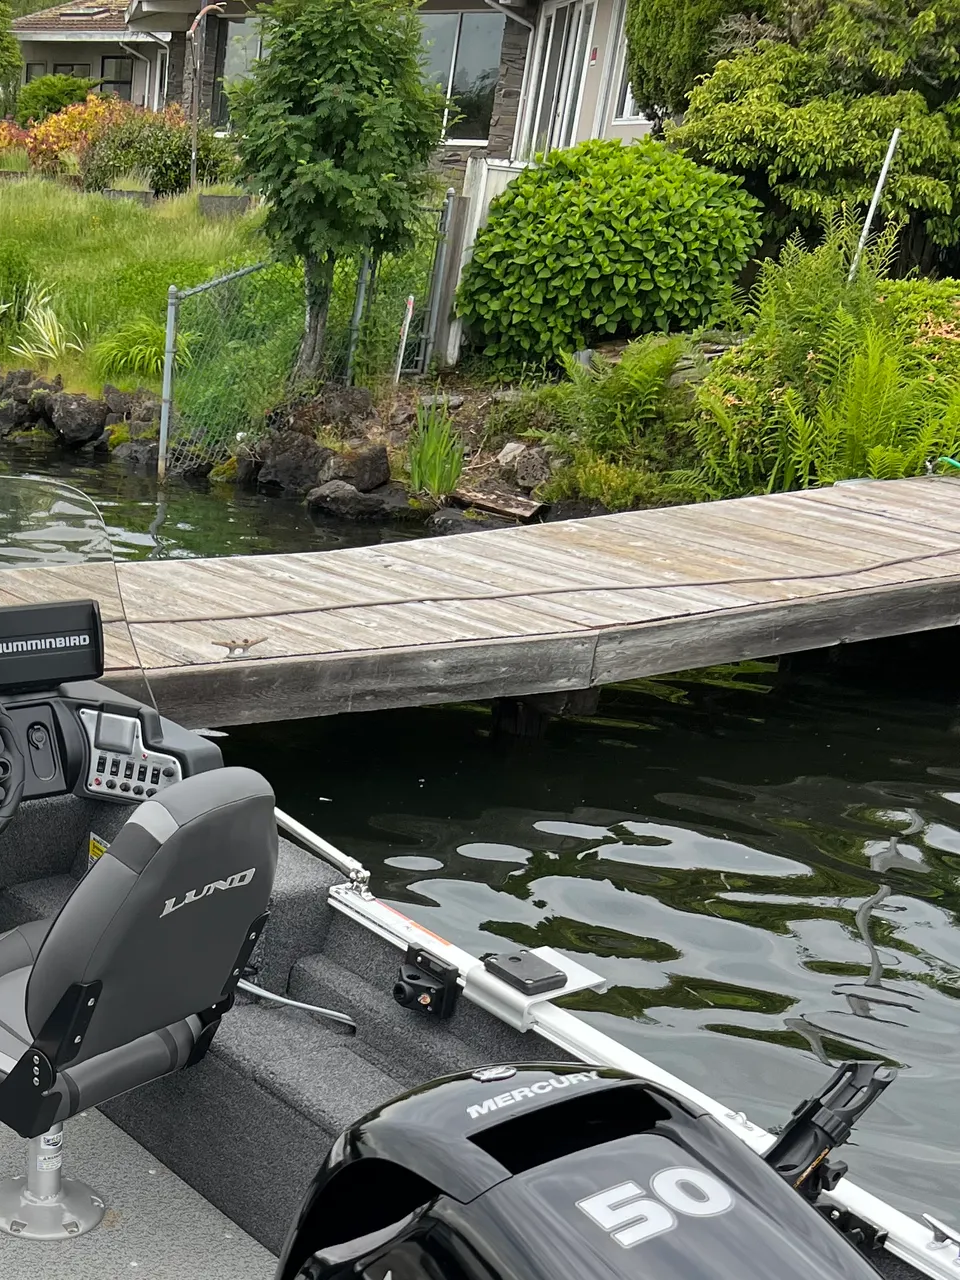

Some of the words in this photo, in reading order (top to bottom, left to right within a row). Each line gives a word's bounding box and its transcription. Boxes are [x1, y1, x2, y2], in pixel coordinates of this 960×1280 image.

[159, 867, 256, 918] LUND
[466, 1071, 600, 1119] MERCURY
[575, 1166, 736, 1249] 50
